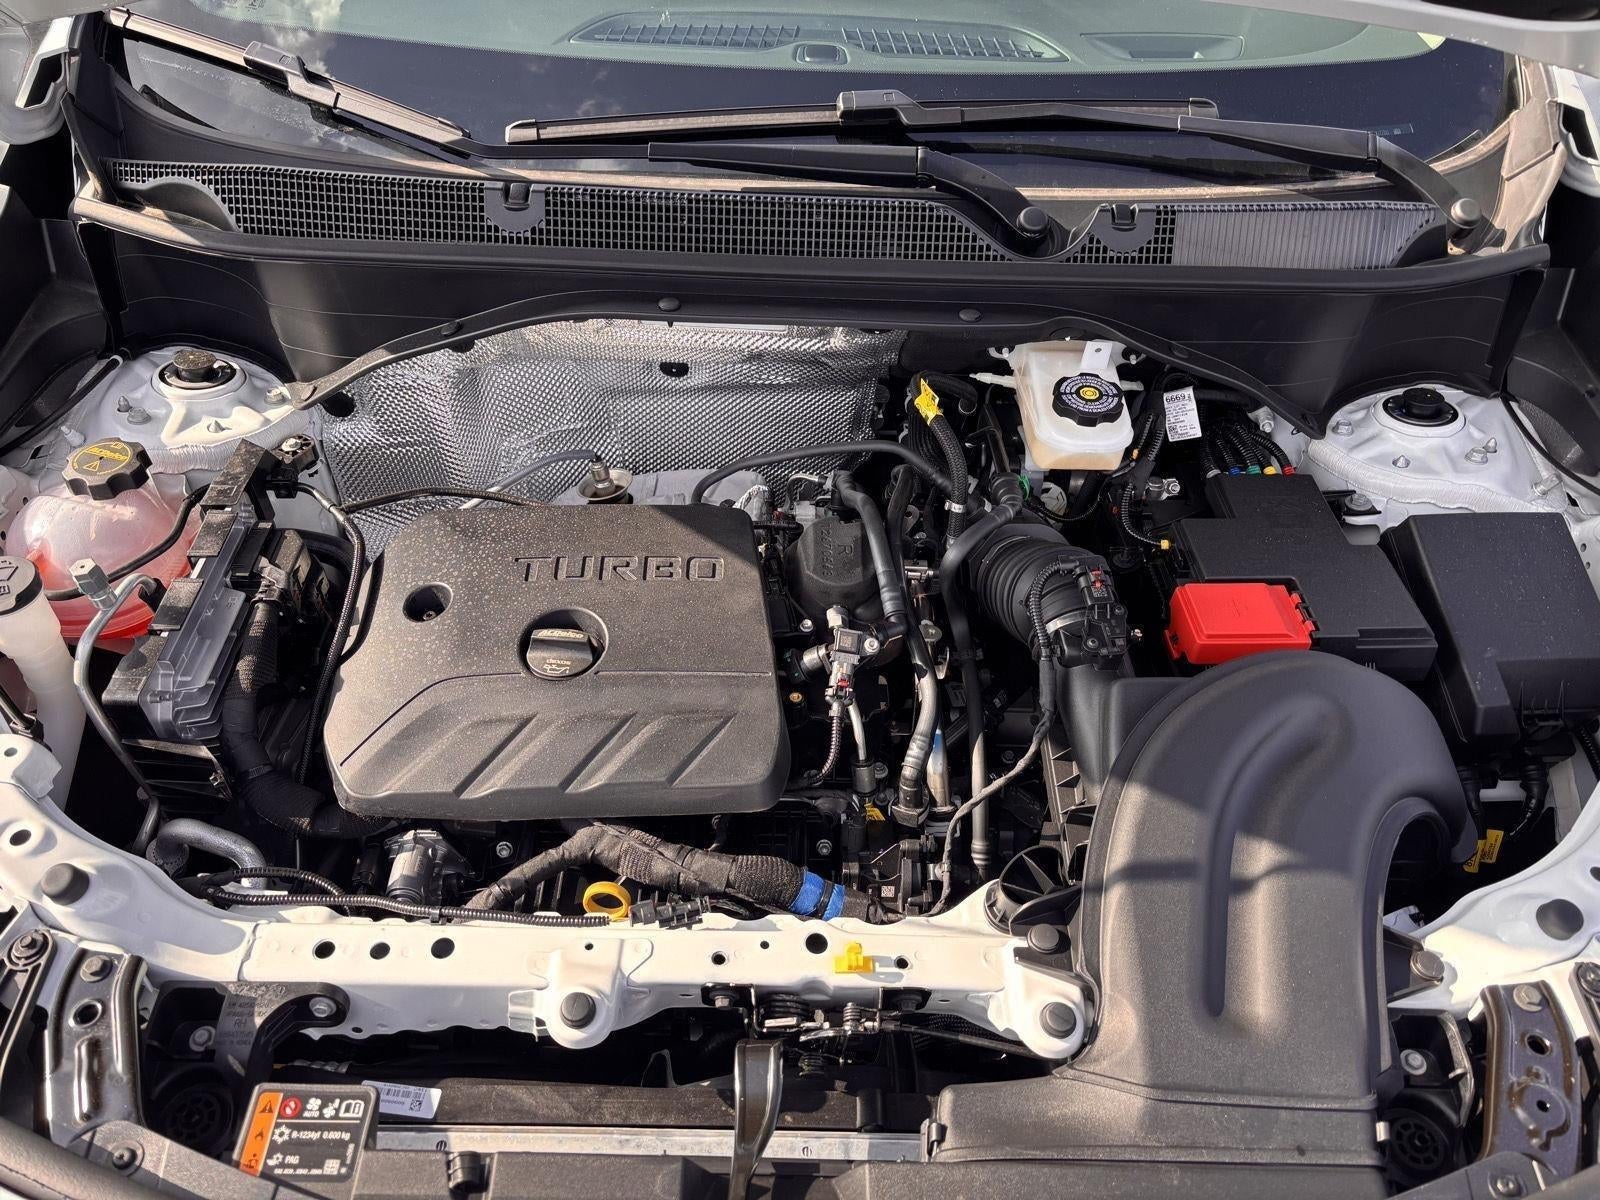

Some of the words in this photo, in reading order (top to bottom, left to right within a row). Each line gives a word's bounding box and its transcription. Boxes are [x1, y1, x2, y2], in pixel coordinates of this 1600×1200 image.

[1165, 393, 1186, 403] 6669
[515, 555, 725, 582] TURBO
[302, 1110, 320, 1118] AUTO
[342, 1131, 351, 1141] kg
[284, 1155, 300, 1165] PAG
